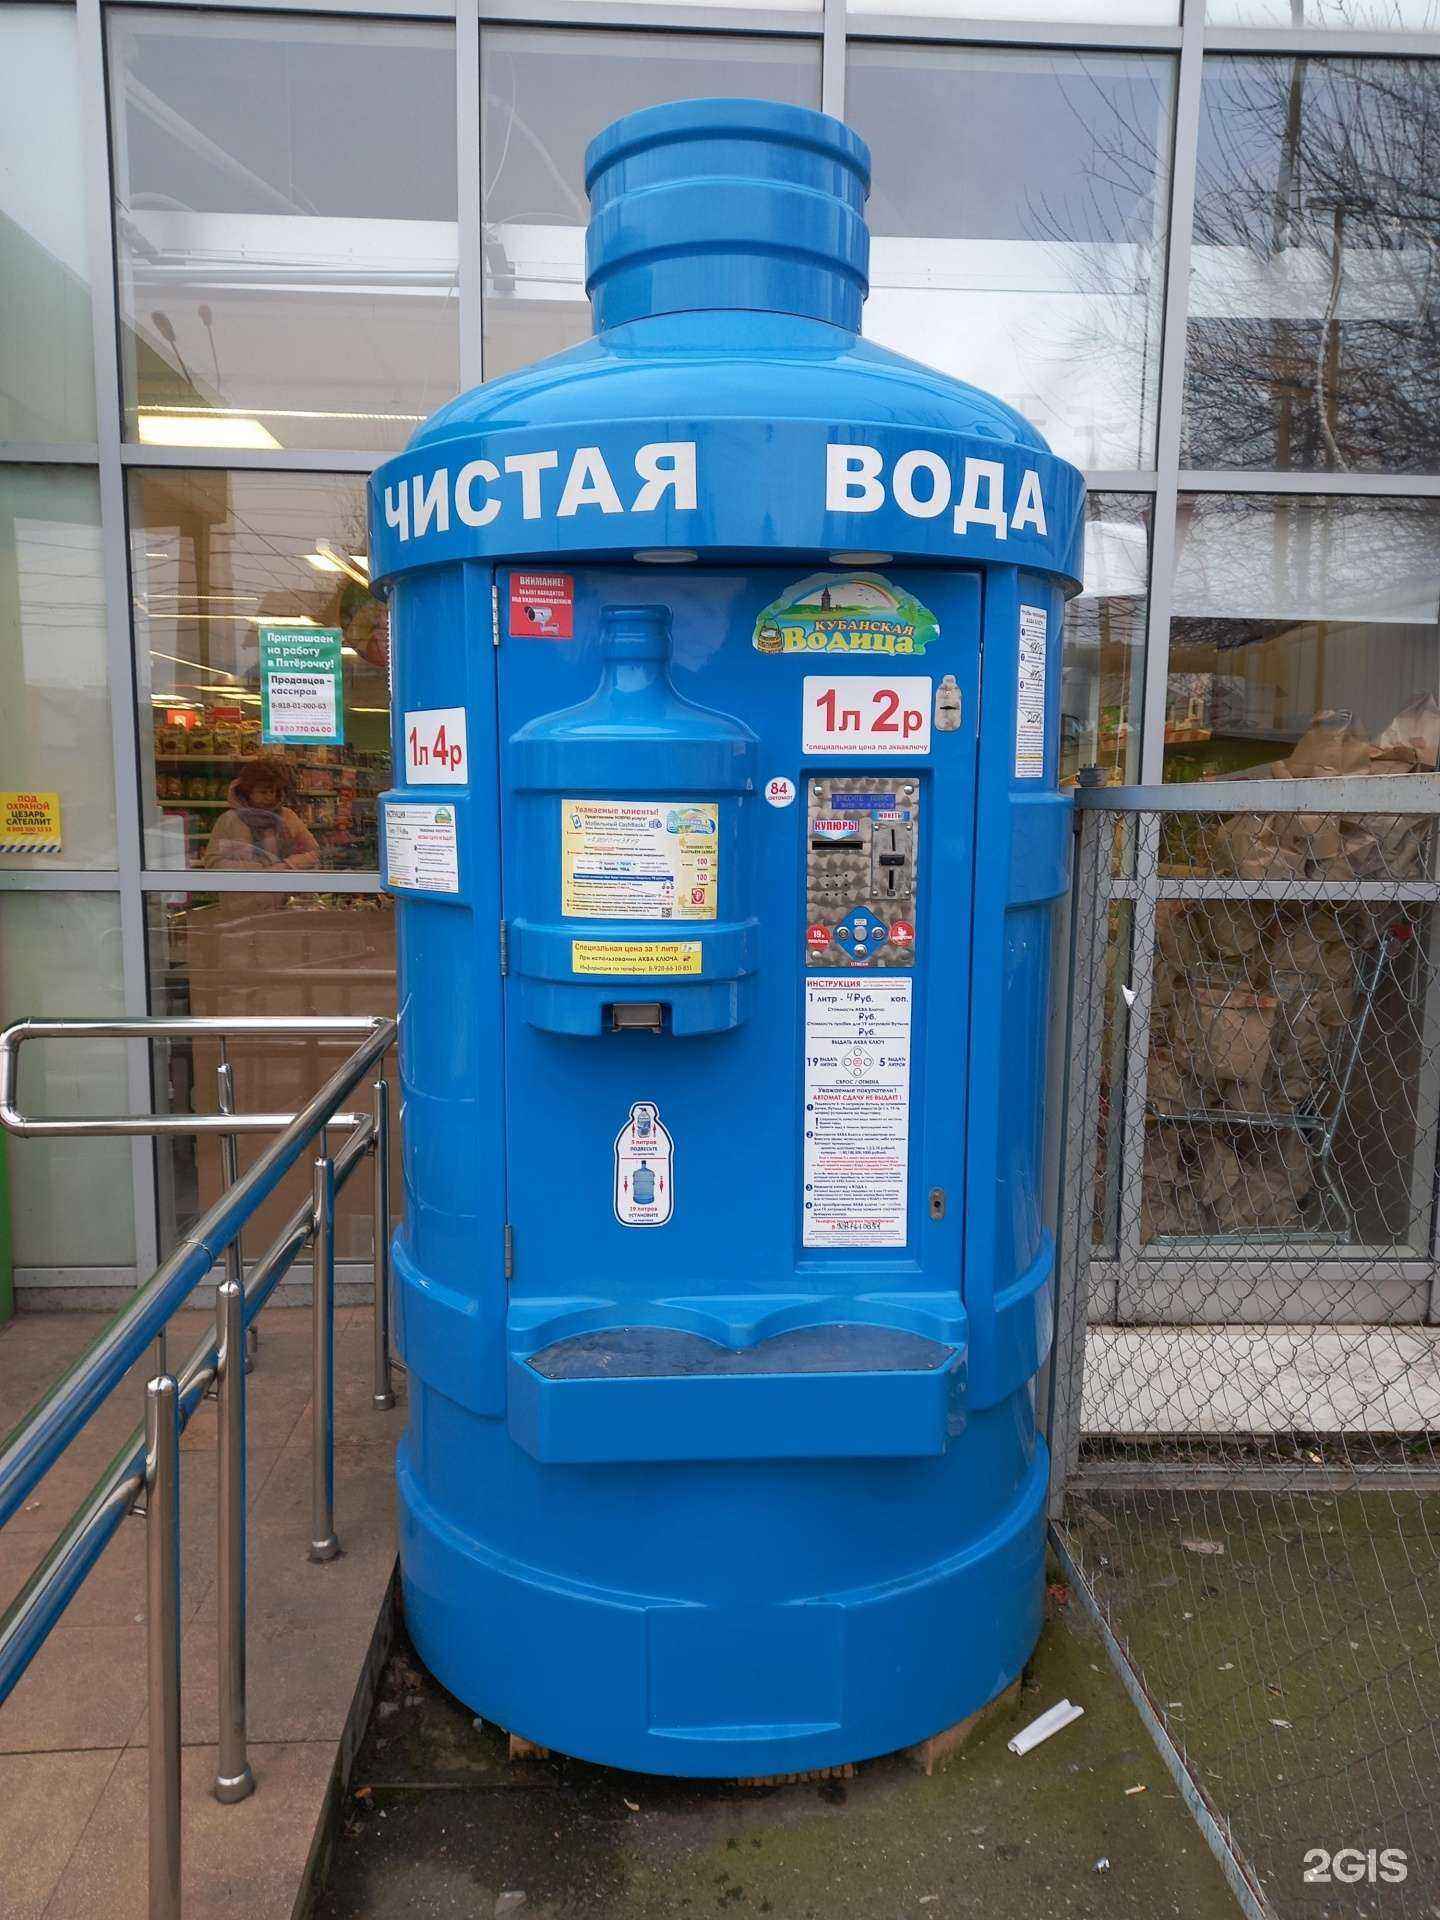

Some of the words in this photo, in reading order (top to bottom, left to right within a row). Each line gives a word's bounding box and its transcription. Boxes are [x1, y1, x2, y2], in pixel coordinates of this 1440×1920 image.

[385, 441, 698, 542] ЧИСТАЯ
[826, 443, 1048, 540] ВОДА
[520, 576, 564, 586] ВНИМАНИЕ!
[816, 620, 914, 634] КУБАНСКАЯ
[268, 633, 334, 643] Приглашаем
[782, 627, 914, 654] Водица
[283, 647, 320, 657] работу
[276, 658, 334, 670] Пятёрочку!
[272, 676, 324, 685] Продавцов
[272, 688, 317, 696] кассиров
[816, 689, 860, 732] 1л
[871, 689, 922, 738] 2р
[410, 727, 428, 766] 1л
[433, 725, 462, 771] 4р
[771, 782, 787, 794] 84
[7, 802, 49, 810] ОХРАНОЙ
[576, 806, 618, 814] Уважаемые
[815, 821, 857, 830] КУПЮРЫ
[575, 943, 622, 952] Специальная
[810, 993, 813, 1002] 1
[807, 1058, 818, 1066] 19
[879, 1058, 886, 1066] 5
